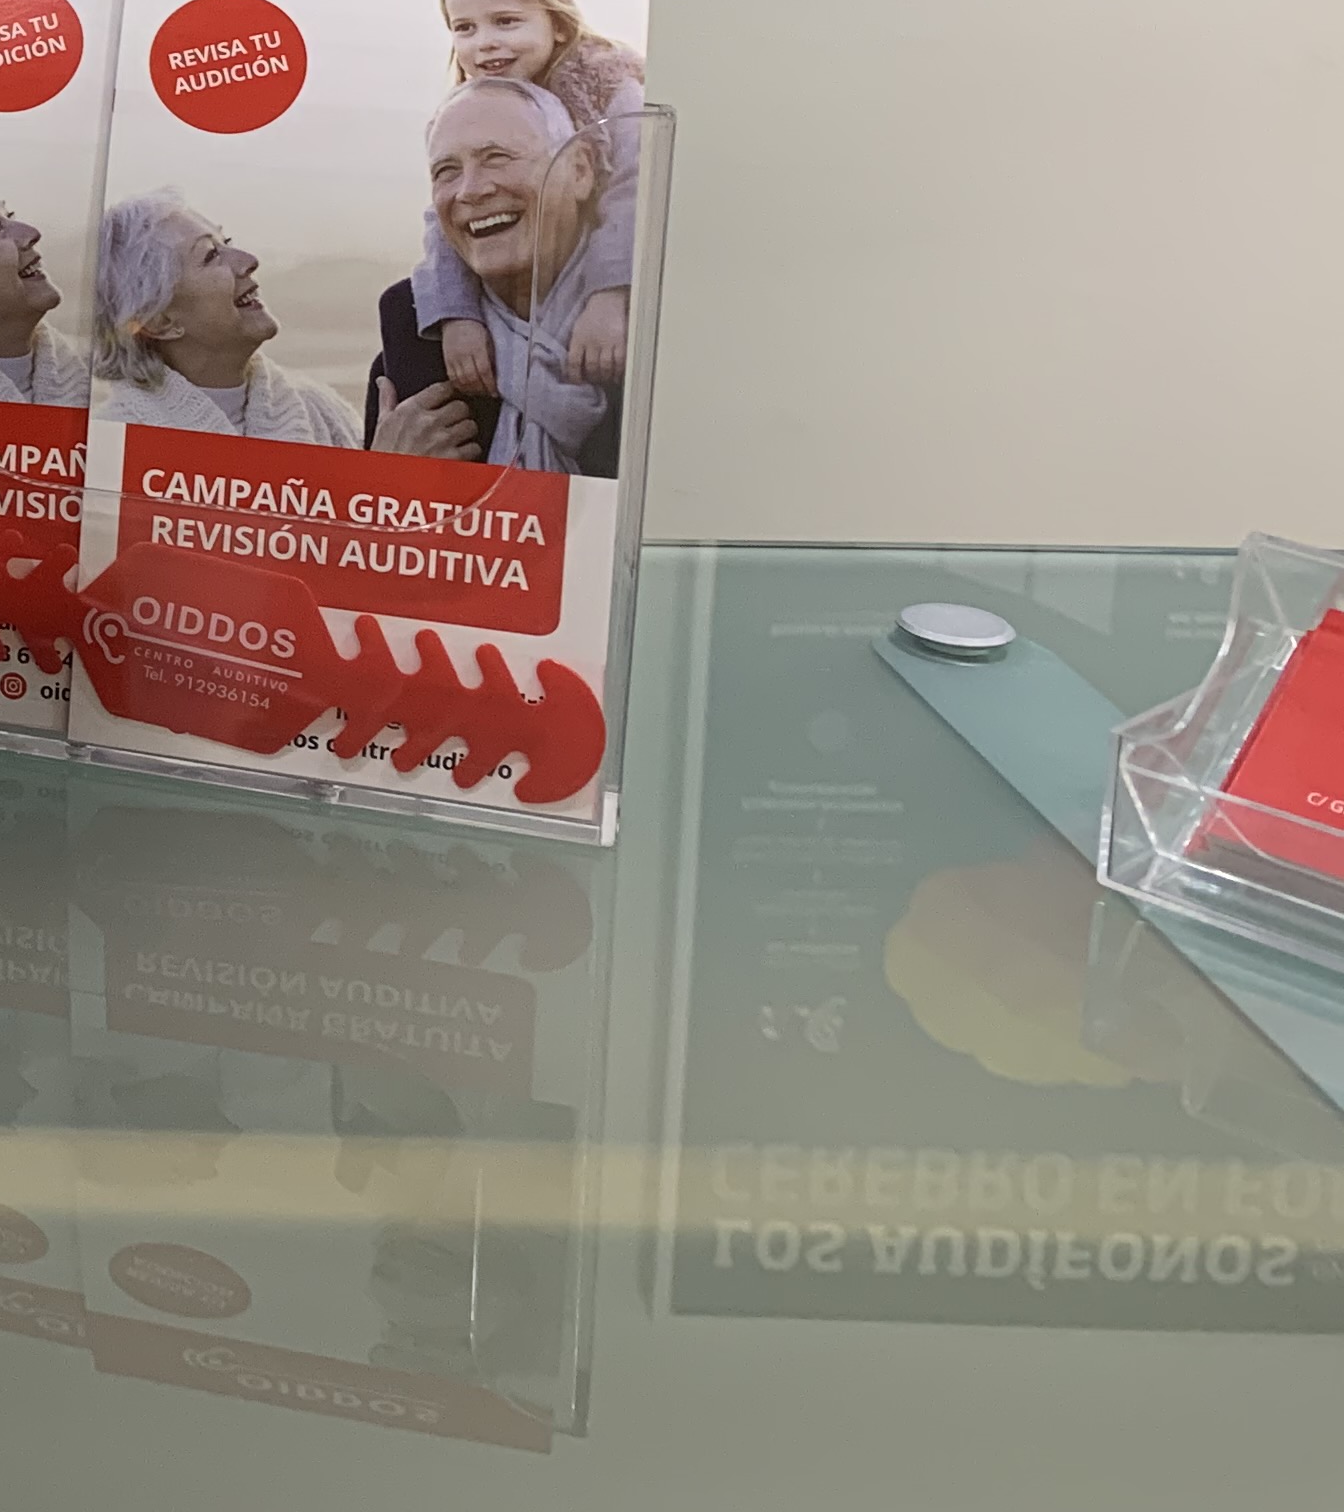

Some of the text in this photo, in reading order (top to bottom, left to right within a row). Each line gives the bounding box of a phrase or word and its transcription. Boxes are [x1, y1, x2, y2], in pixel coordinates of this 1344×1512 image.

[29, 13, 60, 36] TU
[168, 30, 282, 71] REVISA TU
[173, 51, 290, 96] AUDICIÓN
[141, 468, 546, 547] CAMPAÑA GRATUITA
[150, 515, 530, 592] REVISIÓN AUDITIVA
[132, 596, 297, 658] OIDDOS
[134, 646, 289, 692] CENTRO AUDITIVO
[143, 664, 270, 710] Tel. 912936154
